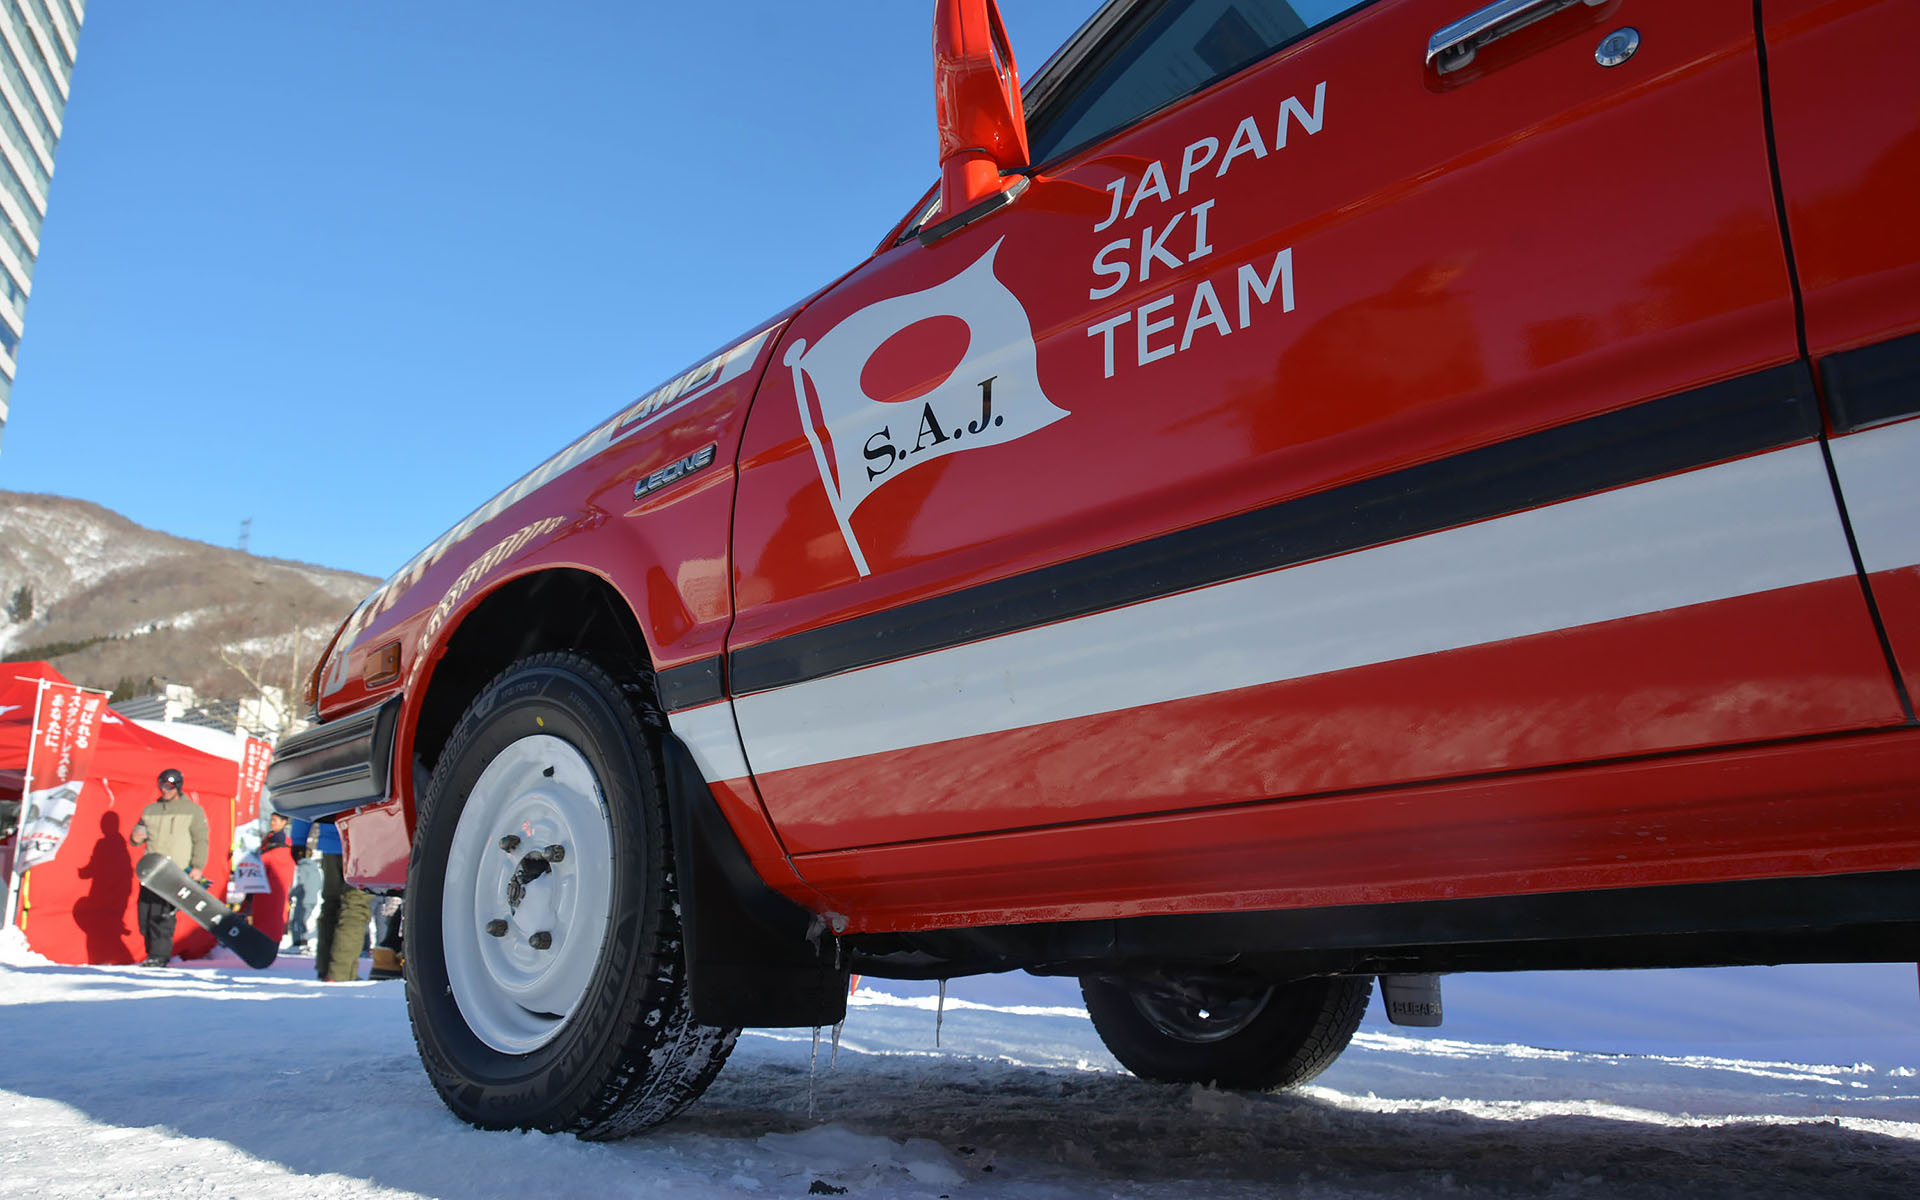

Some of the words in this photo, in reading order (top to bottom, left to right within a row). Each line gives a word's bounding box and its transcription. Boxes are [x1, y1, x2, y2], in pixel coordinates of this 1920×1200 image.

[1093, 80, 1327, 233] JAPAN
[1089, 198, 1215, 300] SKI
[1087, 247, 1295, 379] TEAM
[633, 445, 715, 498] LEONE
[863, 375, 1004, 482] S.A.J.
[177, 886, 240, 937] HEAD
